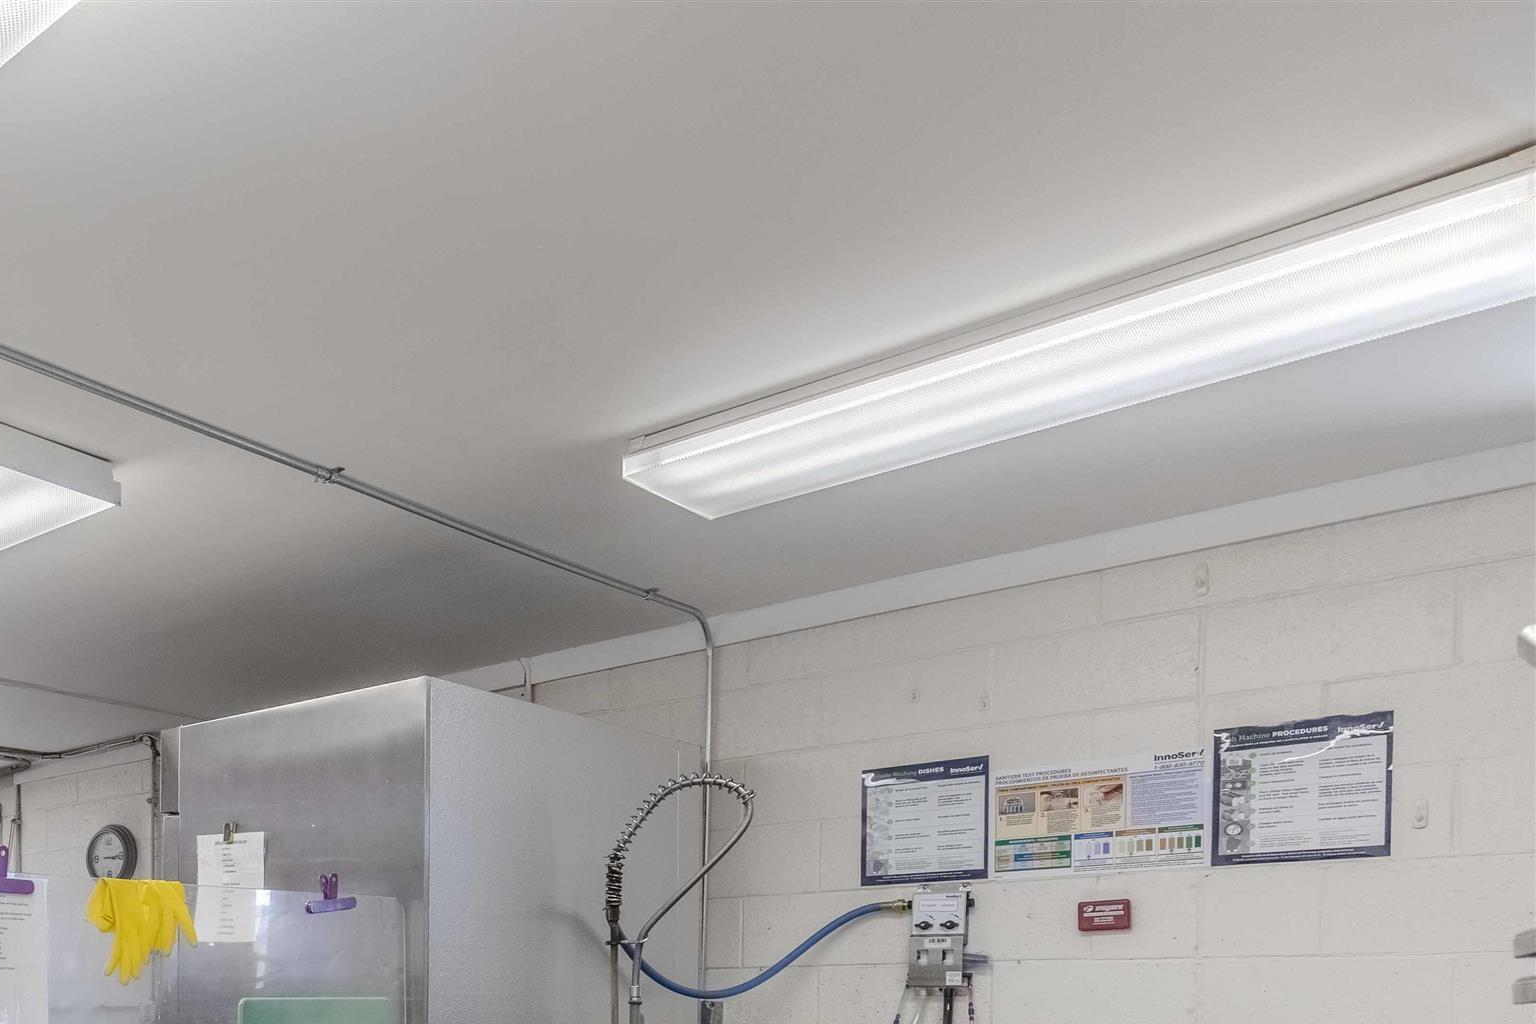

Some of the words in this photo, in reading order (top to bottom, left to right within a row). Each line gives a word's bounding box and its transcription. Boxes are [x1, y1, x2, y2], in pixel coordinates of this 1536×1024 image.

[1238, 732, 1271, 742] Machine
[1272, 725, 1329, 738] PROCEDURES
[918, 766, 944, 775] DISHES
[950, 764, 983, 774] InnoServ
[995, 773, 1021, 781] SANITIZER
[1035, 768, 1071, 777] PROCEDURES
[995, 776, 1042, 786] PROCEDIMIENTOS
[1080, 767, 1128, 777] DESINFECTANTES
[94, 855, 100, 864] 9
